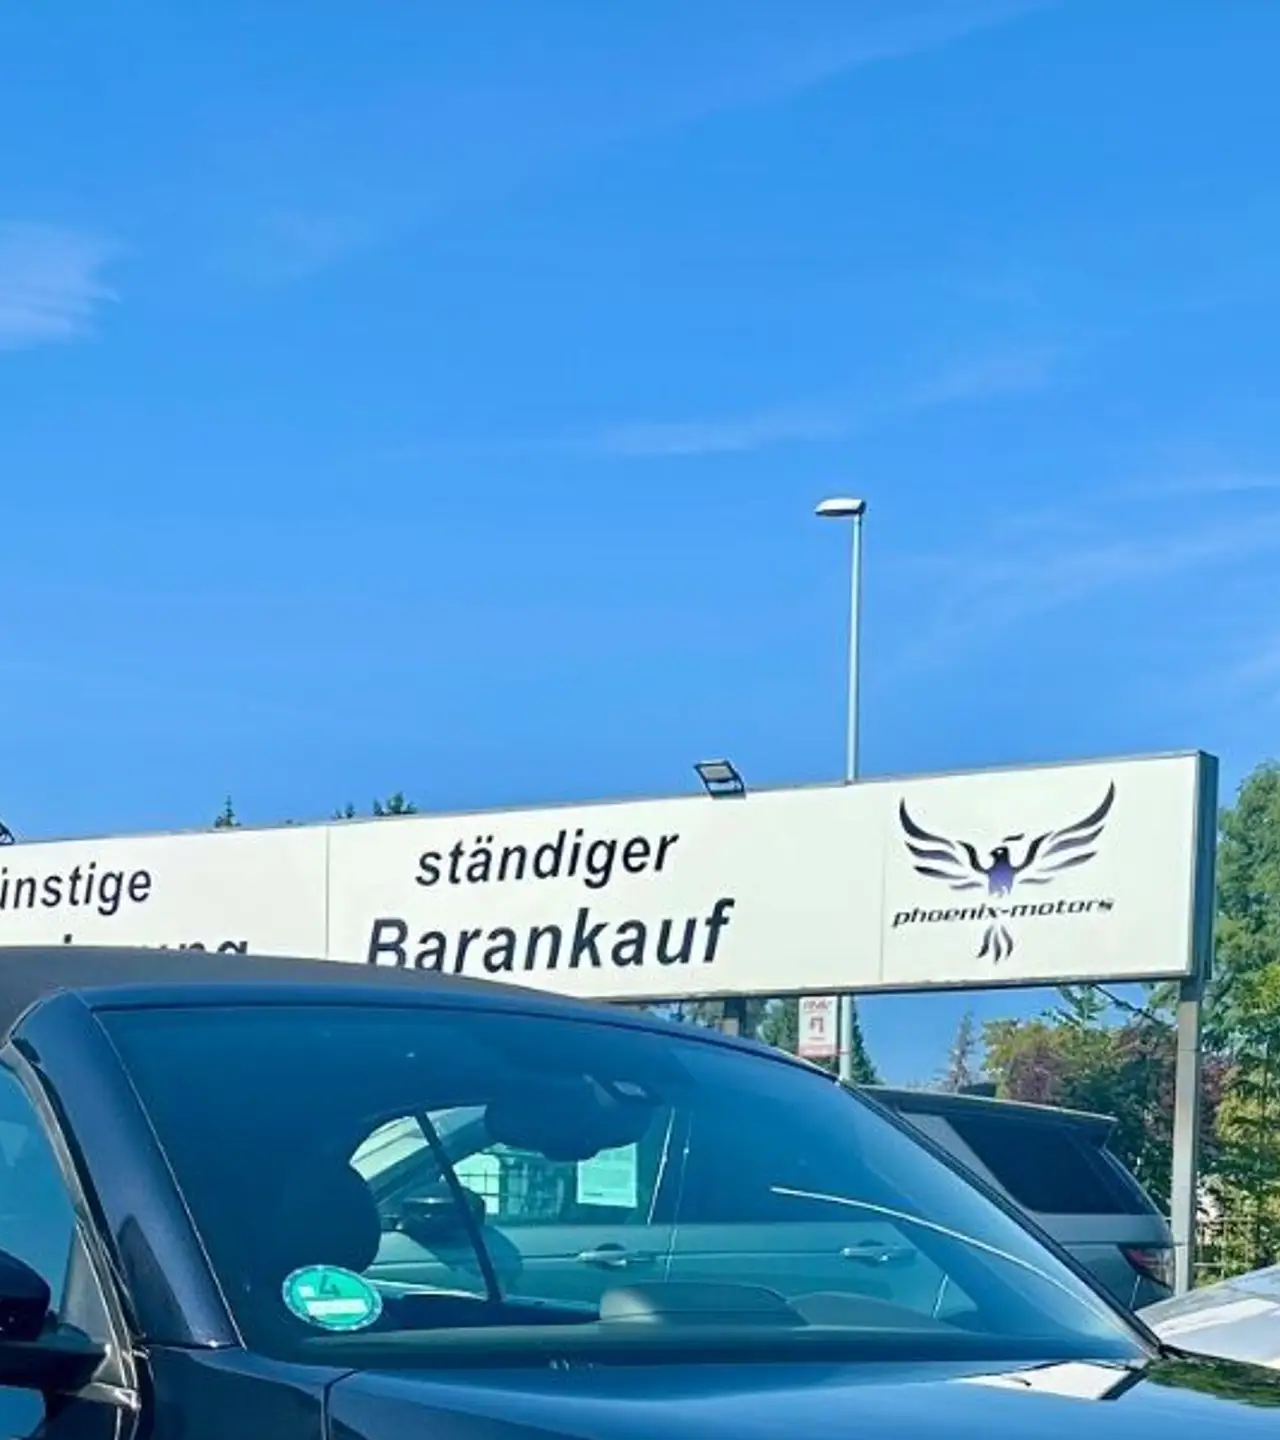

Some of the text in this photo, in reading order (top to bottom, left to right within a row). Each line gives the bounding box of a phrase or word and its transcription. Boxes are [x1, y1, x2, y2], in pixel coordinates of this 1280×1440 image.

[415, 828, 679, 889] ständiger
[367, 898, 734, 974] Barankauf
[891, 899, 1116, 929] phoenix-motors
